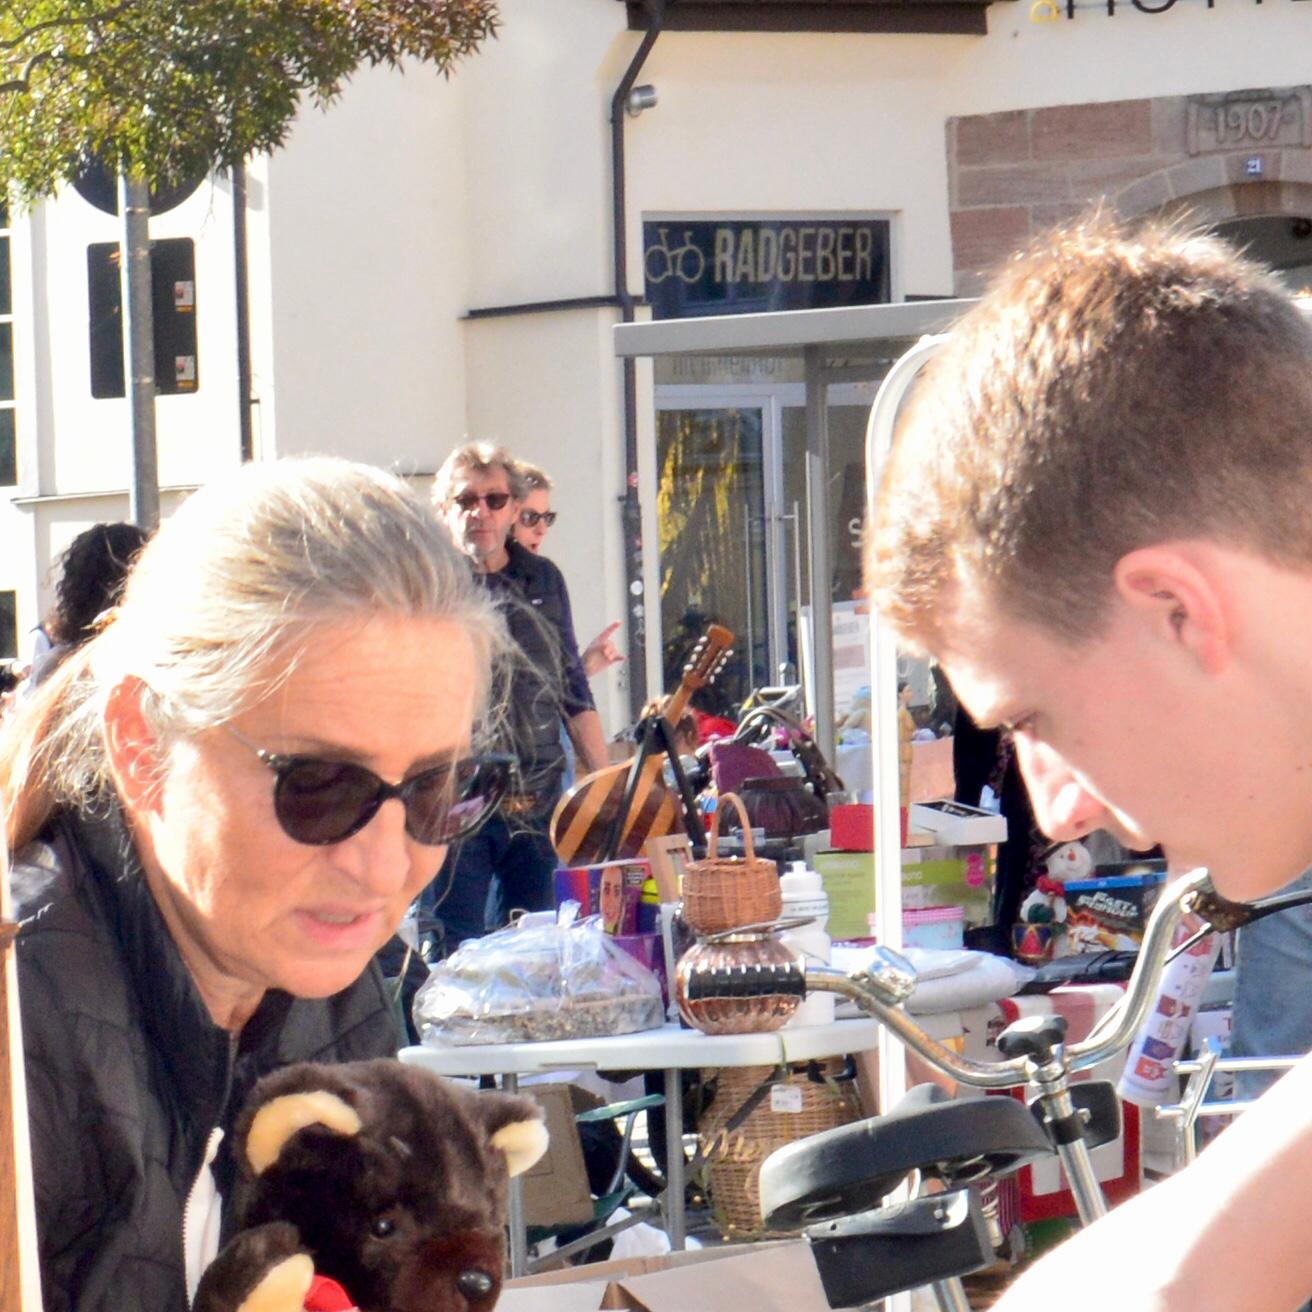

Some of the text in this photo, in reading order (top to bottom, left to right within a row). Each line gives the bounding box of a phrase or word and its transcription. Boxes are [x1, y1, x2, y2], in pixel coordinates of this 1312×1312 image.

[1213, 102, 1284, 144] 1907
[1246, 159, 1262, 174] 21
[714, 227, 873, 284] RADGEBER
